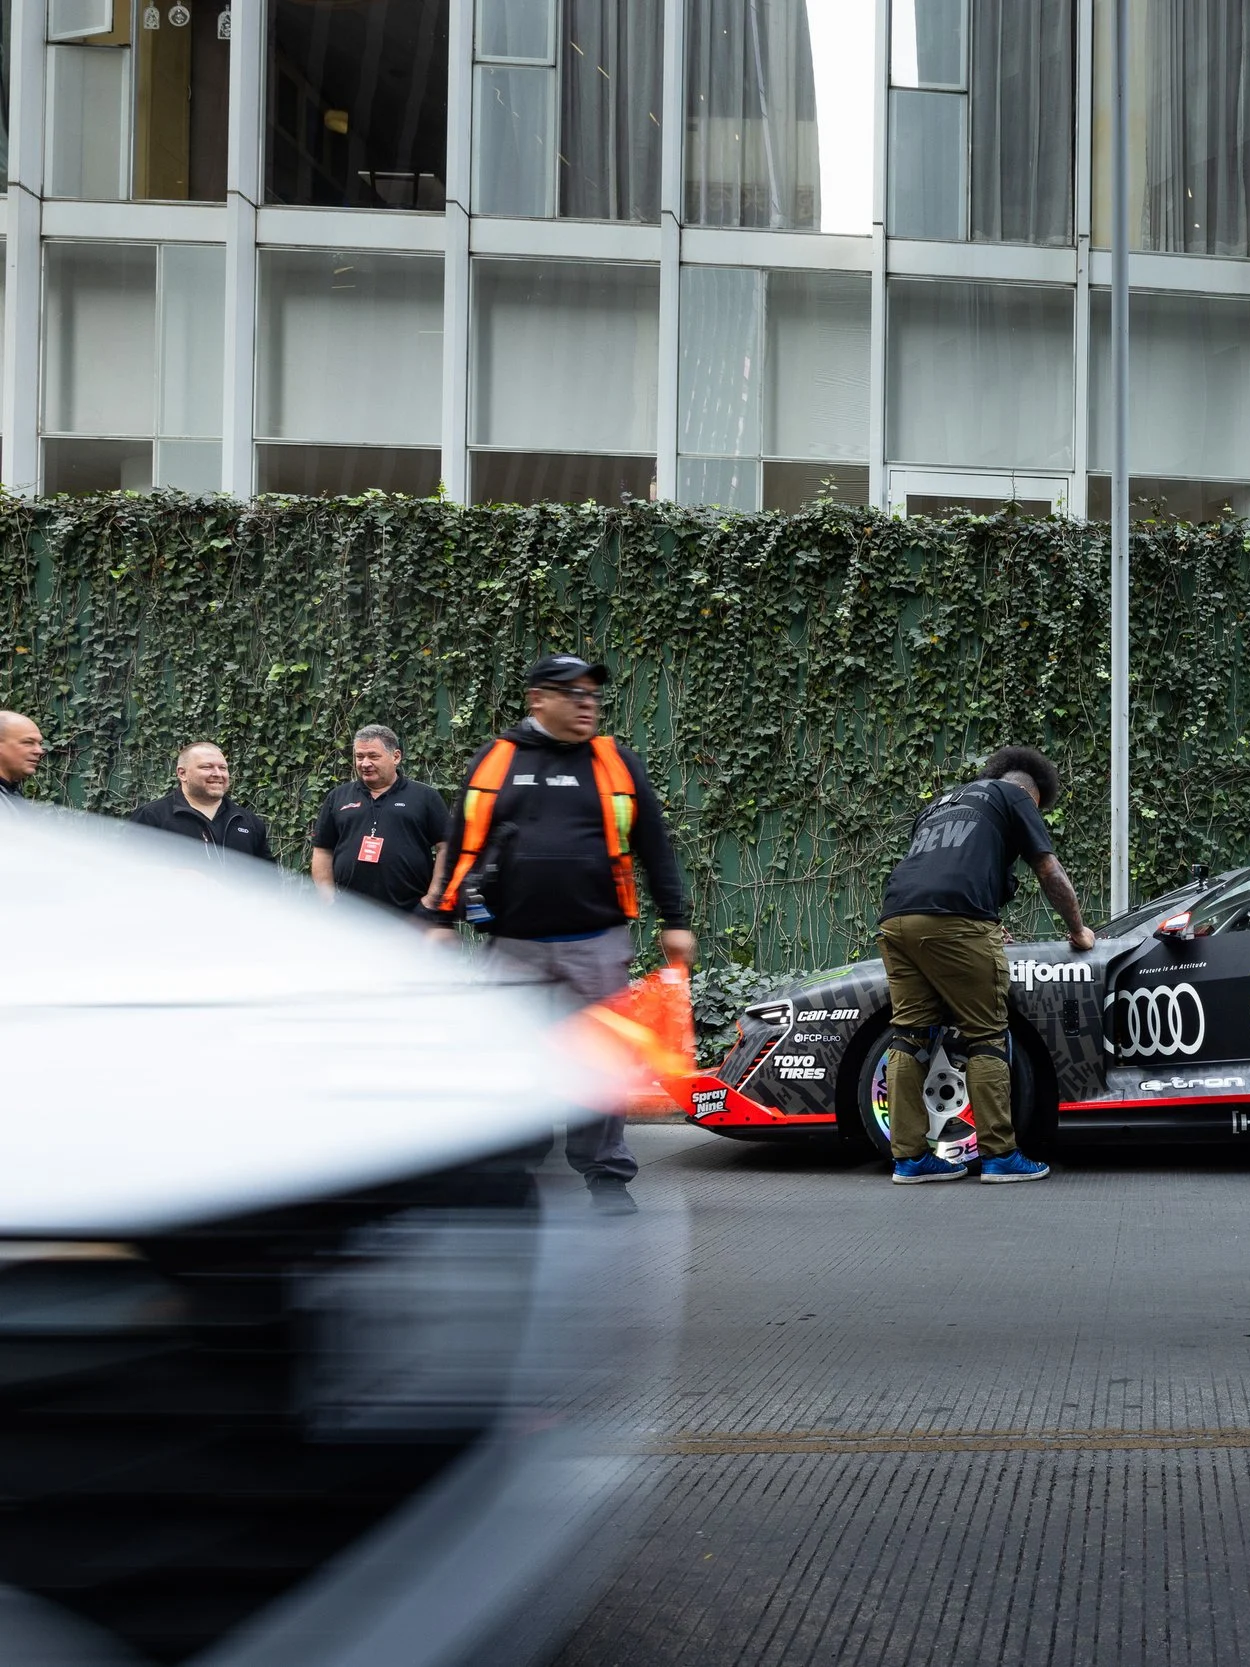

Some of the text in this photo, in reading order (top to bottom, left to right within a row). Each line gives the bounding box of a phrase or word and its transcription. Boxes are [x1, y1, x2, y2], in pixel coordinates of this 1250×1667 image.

[908, 819, 978, 858] REW
[1178, 961, 1207, 970] Attitude
[1009, 960, 1092, 992] tiform
[797, 1008, 859, 1021] can-am
[803, 1034, 822, 1042] FCP
[773, 1055, 815, 1067] TOYO
[779, 1067, 826, 1079] TIRES
[1140, 1076, 1246, 1091] e-tron
[692, 1089, 727, 1103] Spray
[697, 1101, 724, 1113] Nine
